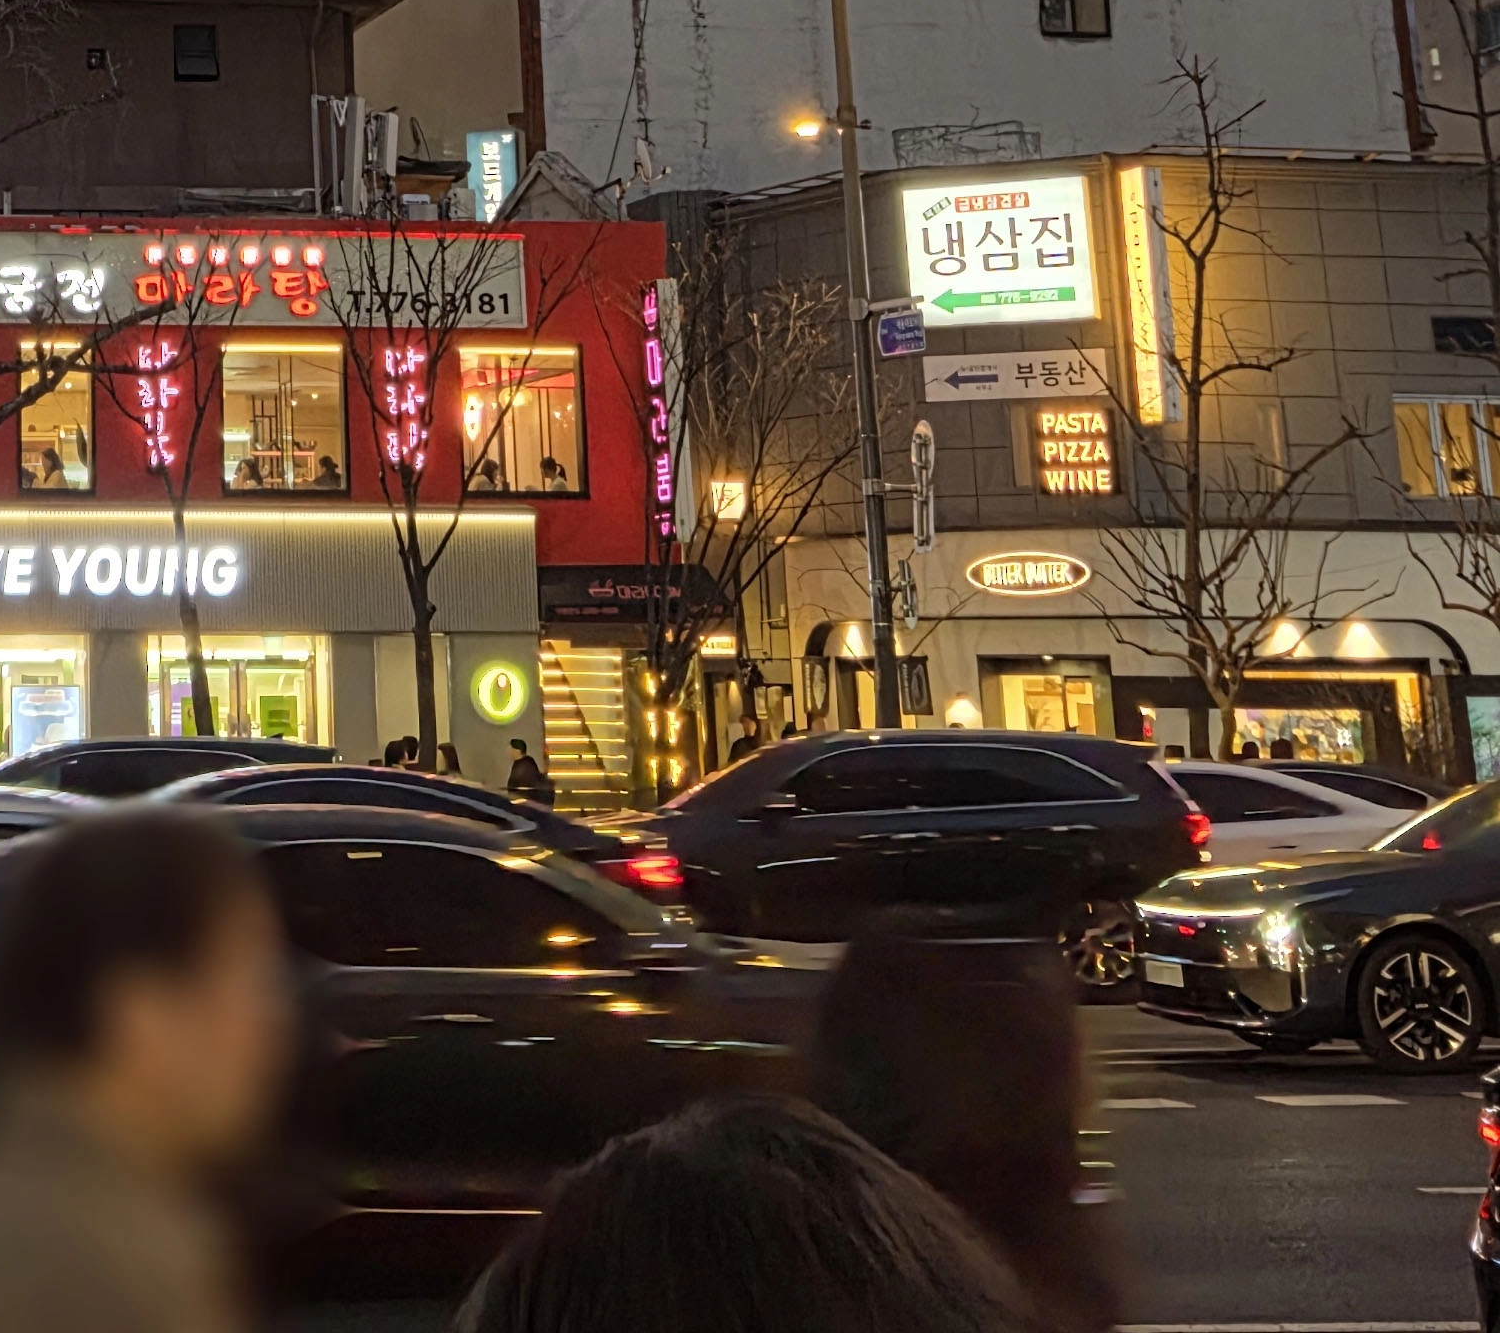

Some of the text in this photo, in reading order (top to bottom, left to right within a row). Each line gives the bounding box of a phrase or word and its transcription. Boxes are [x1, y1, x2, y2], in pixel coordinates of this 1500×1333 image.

[922, 213, 1075, 276] 냉삼집
[134, 271, 329, 318] 마라탕
[1015, 360, 1086, 389] 부동산
[1041, 412, 1108, 435] PASTA
[1043, 440, 1110, 463] PIZZA
[1045, 468, 1113, 493] WINE
[51, 546, 239, 598] YOUNG
